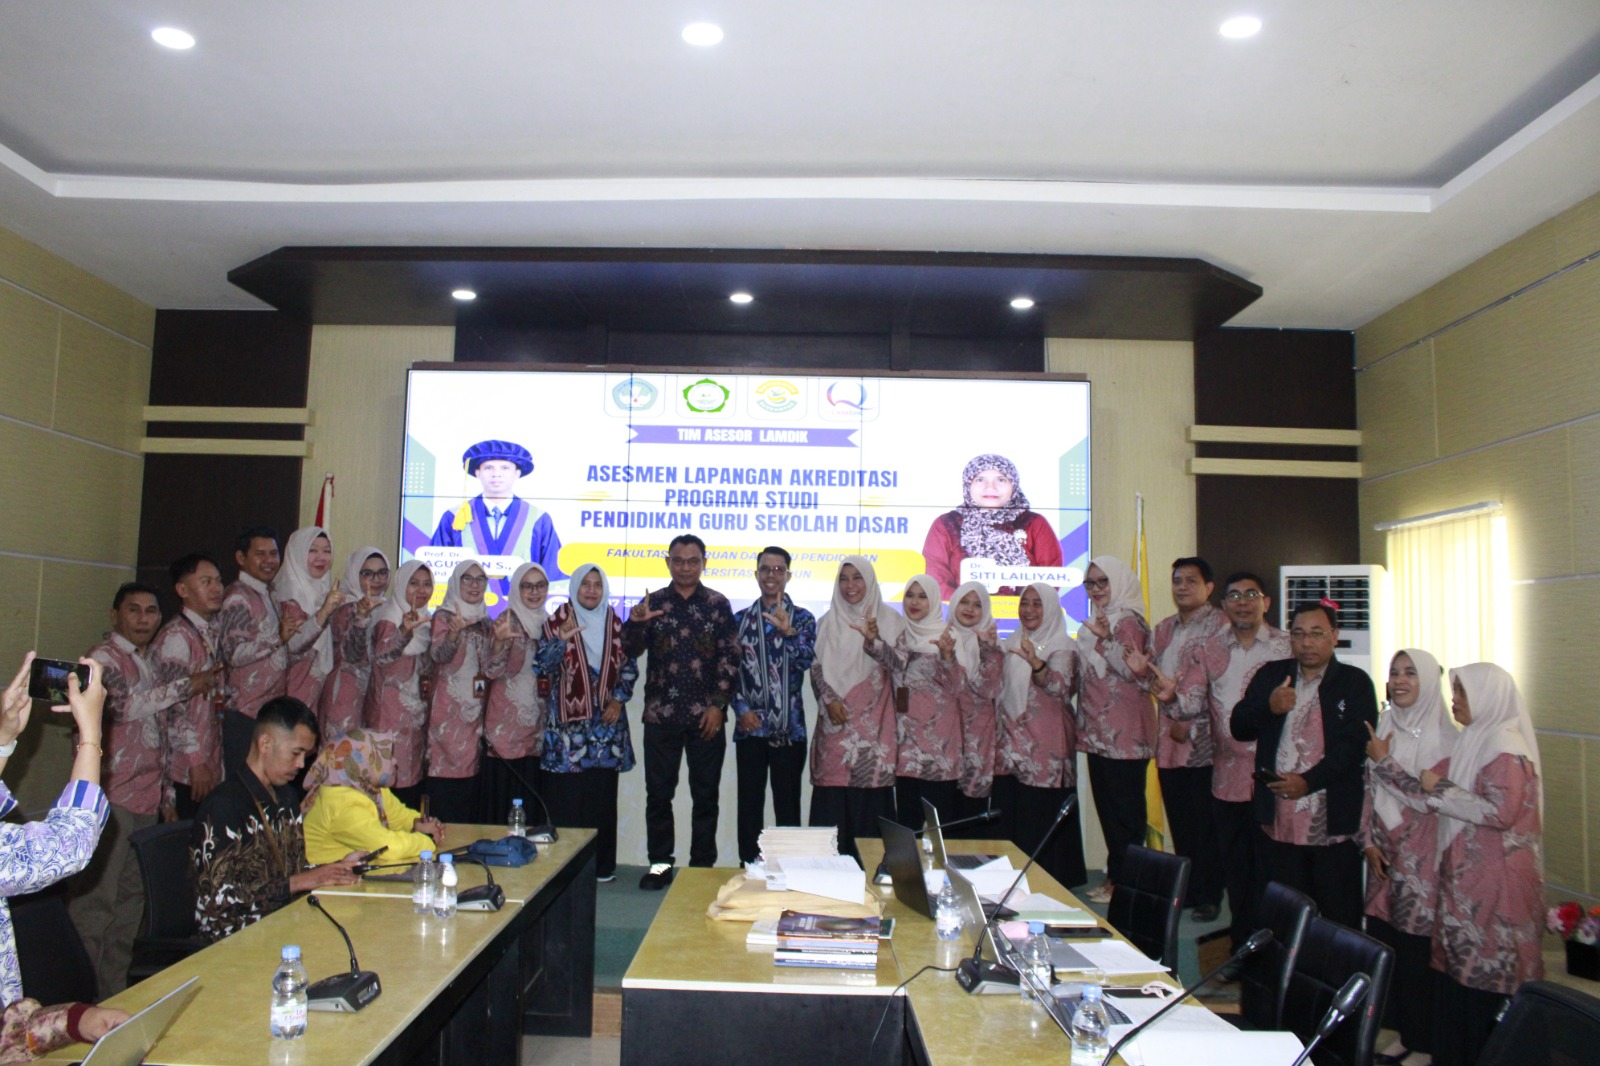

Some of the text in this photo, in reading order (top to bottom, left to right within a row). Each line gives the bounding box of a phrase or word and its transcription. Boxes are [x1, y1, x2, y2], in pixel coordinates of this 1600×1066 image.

[677, 428, 808, 443] TIM ASESOR LAMDIK
[586, 464, 898, 488] ASESMEN LAPANGAN AKREDITASI
[665, 489, 818, 510] PROGRAM STUDI
[581, 510, 908, 534] PENDIDIKAN GURU SEKOLAH DASAR
[606, 548, 670, 559] FAKULTAS
[740, 551, 757, 560] DA
[425, 559, 491, 569] AGUSN
[703, 567, 754, 577] ERSITAS
[970, 571, 1071, 582] SITI LAILIYAH,
